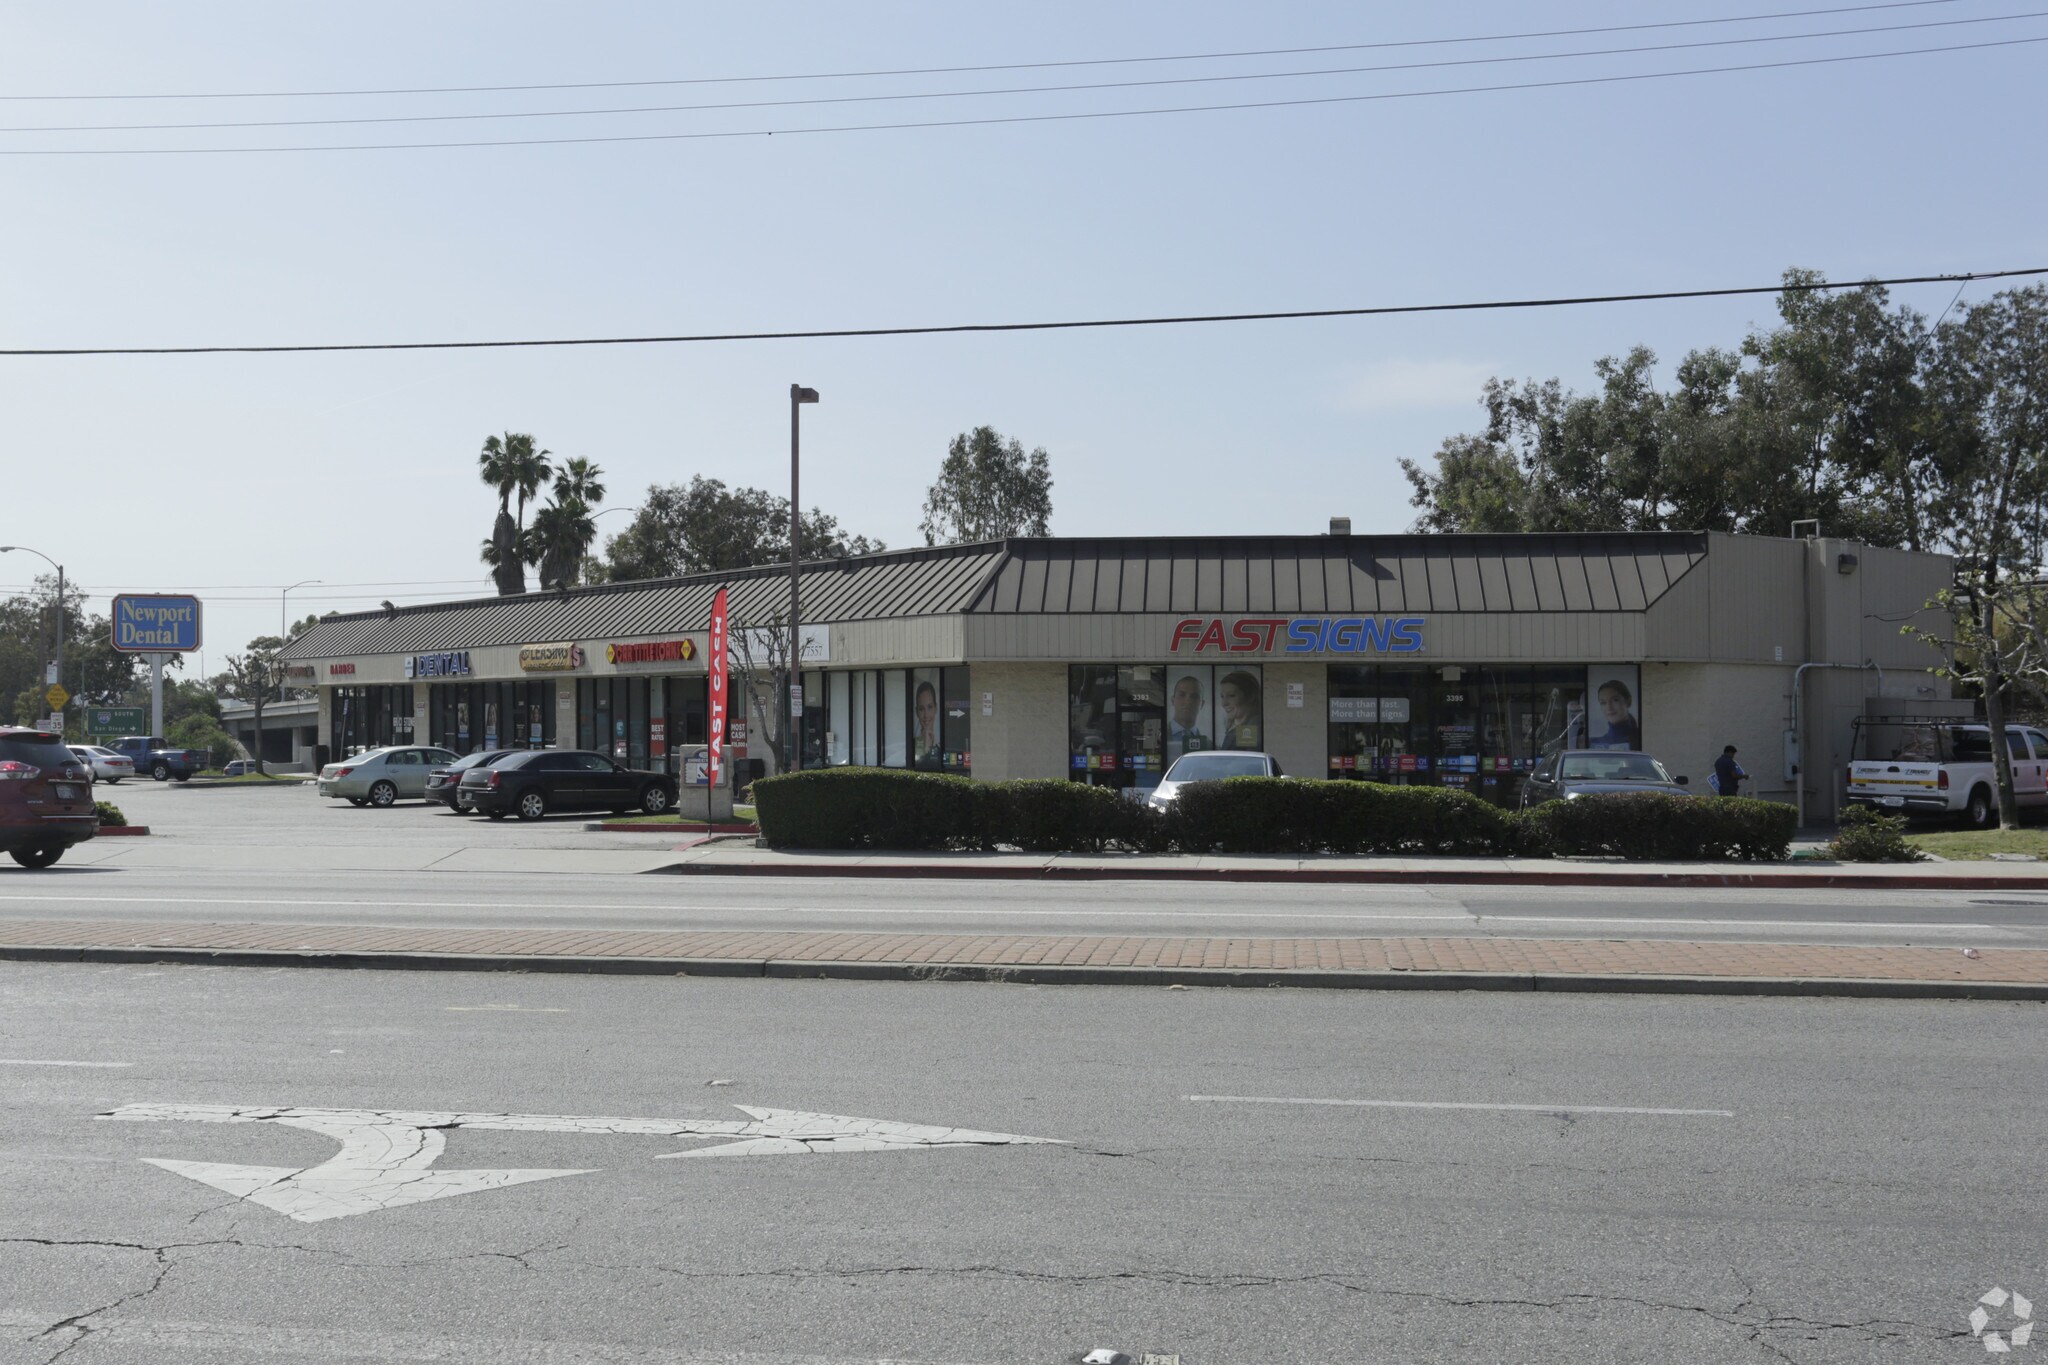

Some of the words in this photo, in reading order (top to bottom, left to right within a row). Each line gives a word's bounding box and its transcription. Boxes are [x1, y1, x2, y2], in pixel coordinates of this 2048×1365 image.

[121, 599, 192, 626] Newport
[121, 622, 180, 644] Dental
[1170, 617, 1426, 653] FASTSIGNS
[616, 644, 634, 664] CAR
[634, 642, 656, 662] TITLE
[713, 616, 722, 692] CASH
[418, 651, 470, 676] DENTAL
[1331, 701, 1354, 709] More
[1356, 700, 1377, 709] than
[1381, 700, 1401, 709] fast.
[1446, 694, 1464, 702] 3395
[1331, 710, 1354, 718] More
[1356, 710, 1377, 718] than
[1381, 710, 1406, 720] signs.
[52, 722, 63, 730] 35
[651, 724, 664, 732] BEST
[731, 723, 745, 732] MOST
[711, 700, 723, 772] FAST
[731, 731, 746, 739] CASH
